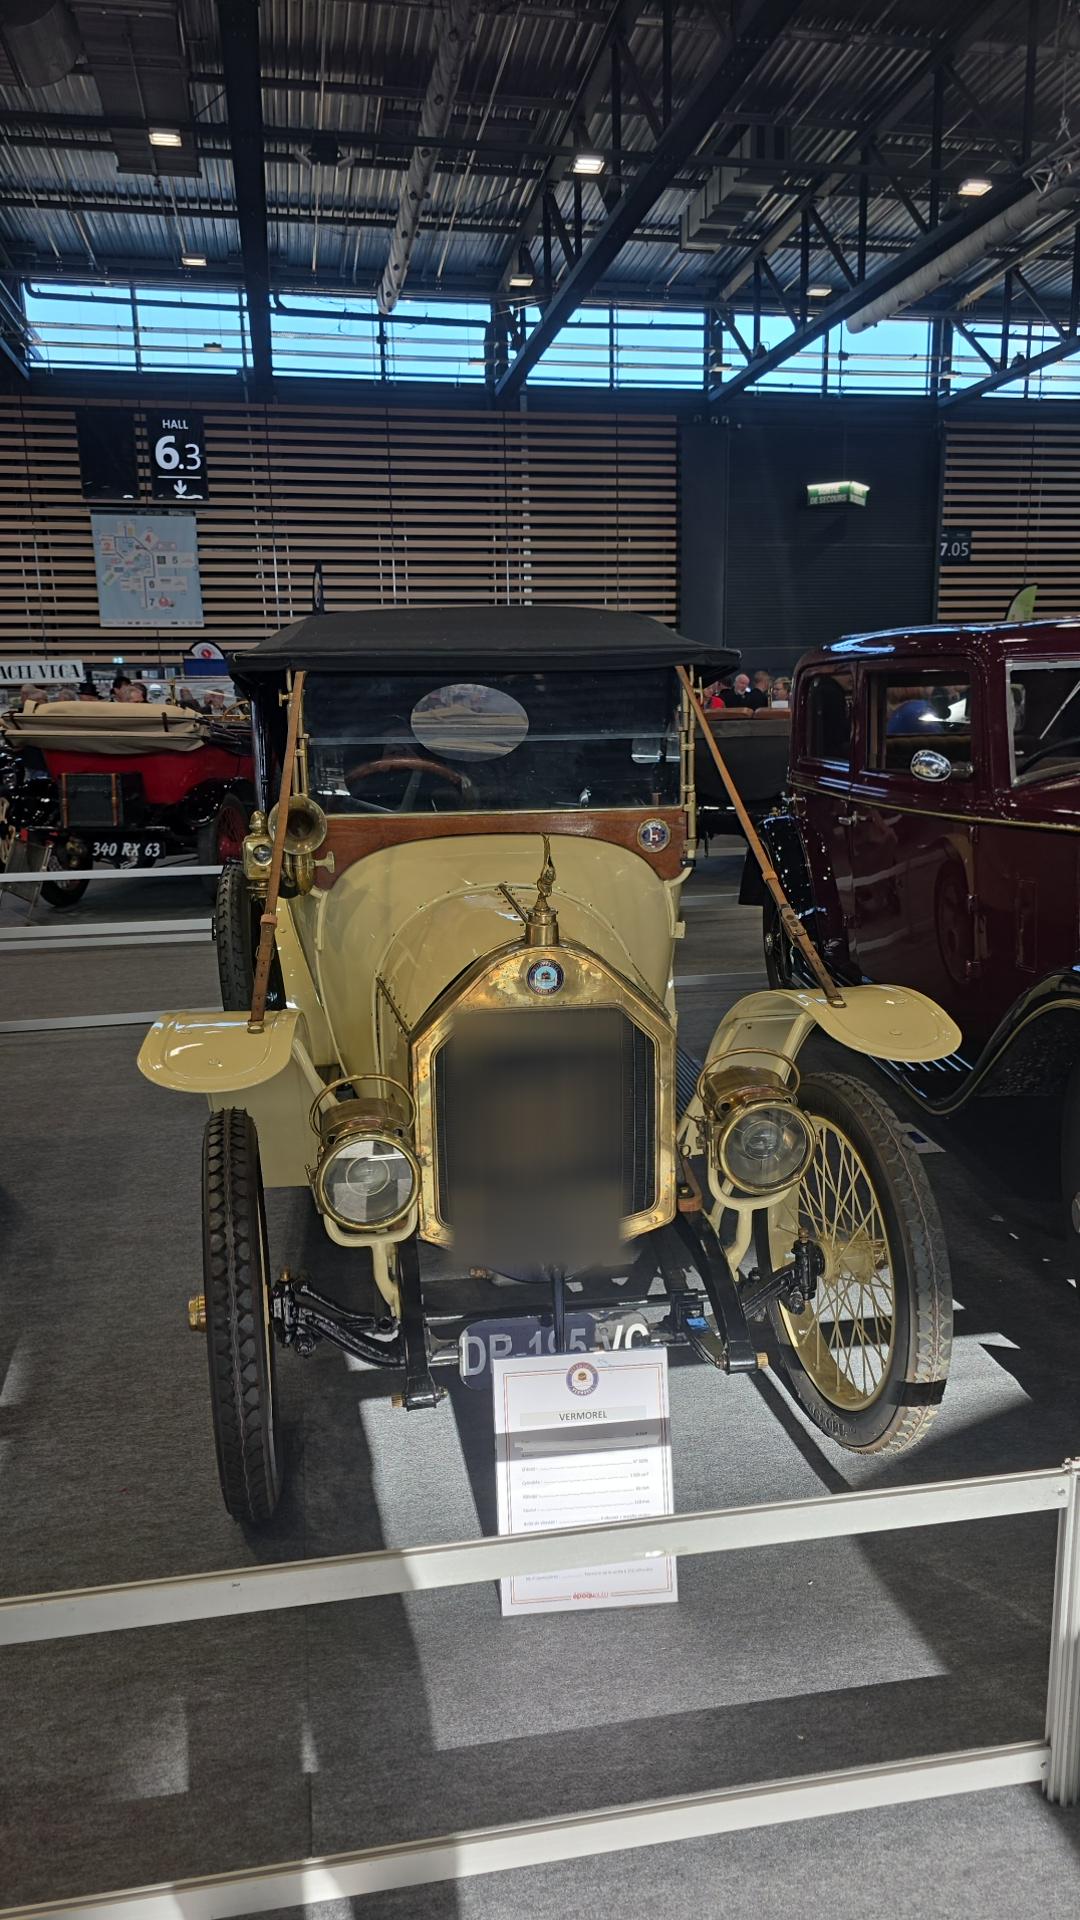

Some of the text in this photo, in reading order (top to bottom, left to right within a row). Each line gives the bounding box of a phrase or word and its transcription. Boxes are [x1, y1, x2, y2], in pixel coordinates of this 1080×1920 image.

[162, 419, 189, 430] HALL
[155, 435, 201, 470] 6.3
[939, 542, 969, 557] 7.05
[92, 842, 161, 857] 340 RX 63
[559, 1411, 608, 1422] VERMOREL
